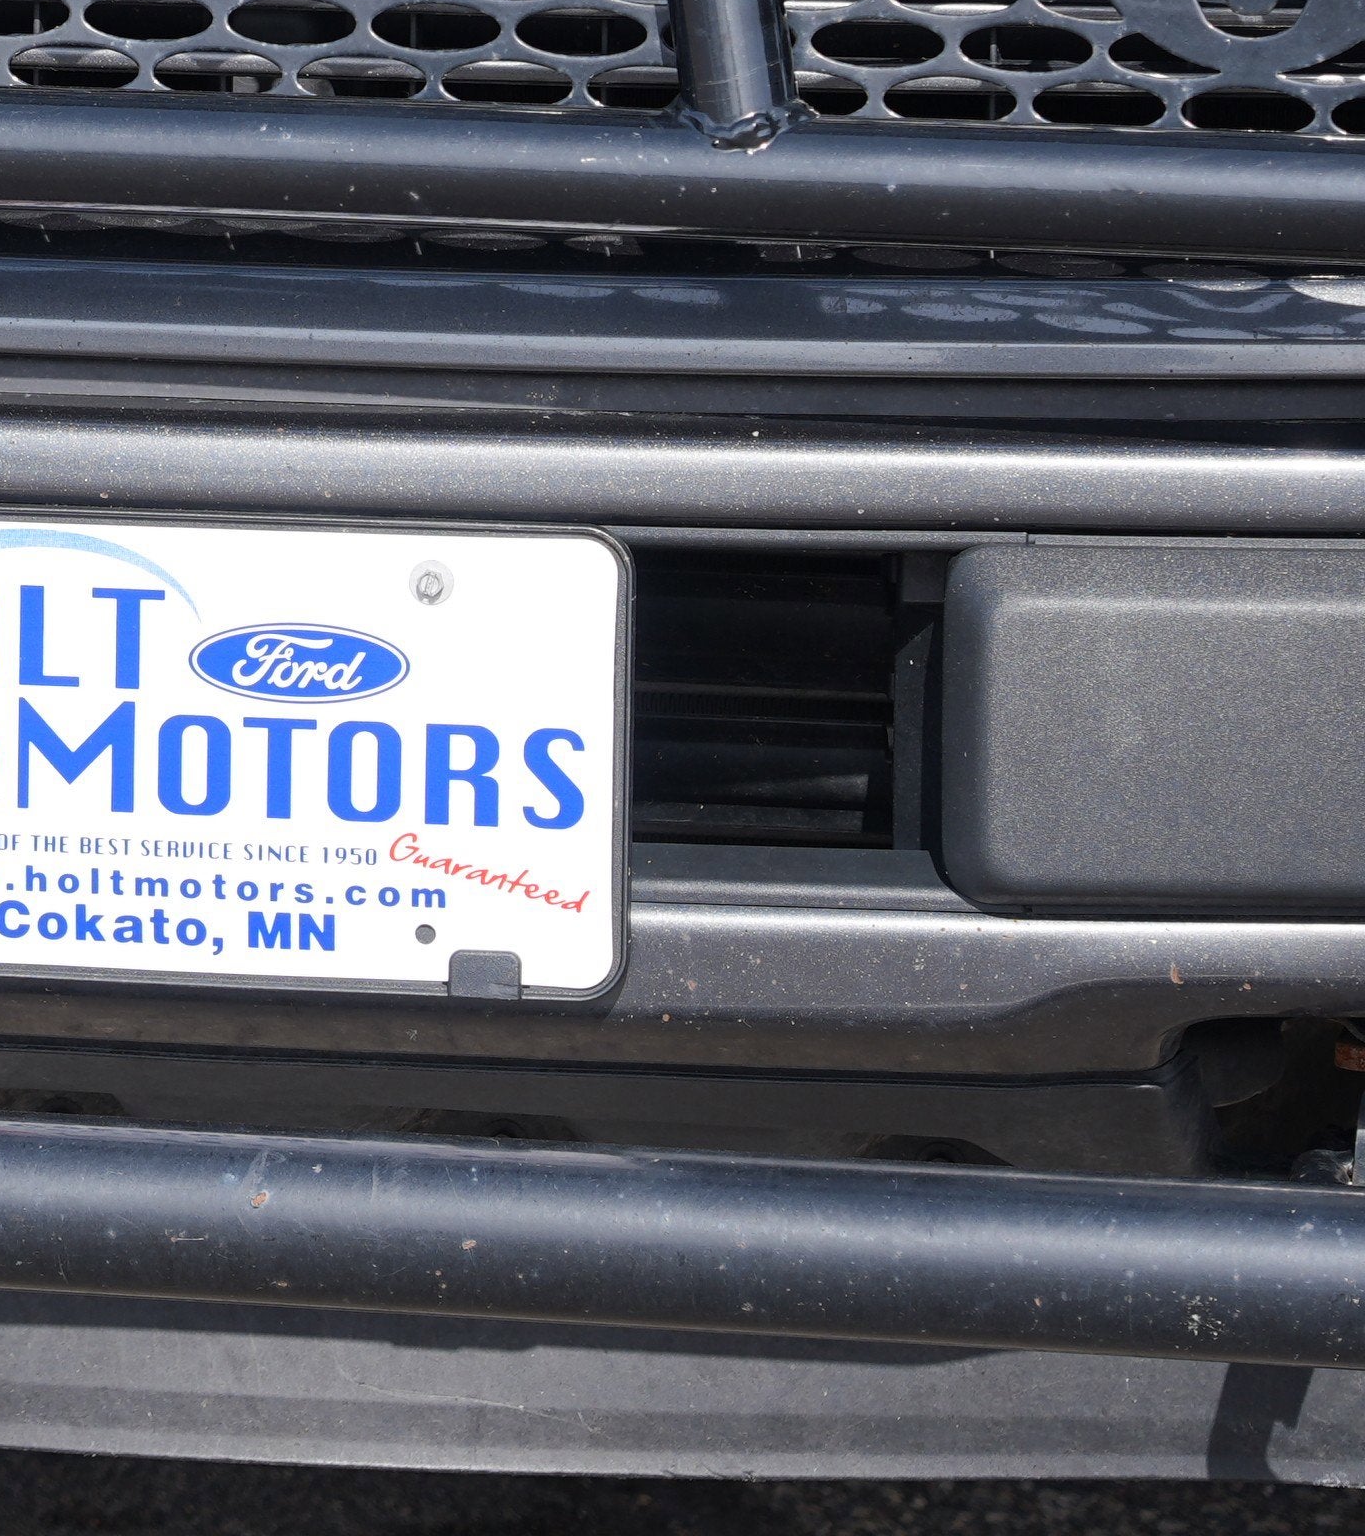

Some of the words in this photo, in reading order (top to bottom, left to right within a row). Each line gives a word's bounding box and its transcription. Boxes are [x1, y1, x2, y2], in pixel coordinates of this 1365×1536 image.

[232, 632, 366, 692] Ford
[18, 697, 586, 830] MOTORS
[30, 835, 69, 853] THE
[79, 837, 132, 856] BEST
[140, 840, 233, 860] SERVICE
[243, 843, 310, 863] SINCE
[322, 846, 377, 866] 1950
[389, 832, 590, 913] Guaranteed
[248, 911, 336, 952] MN
